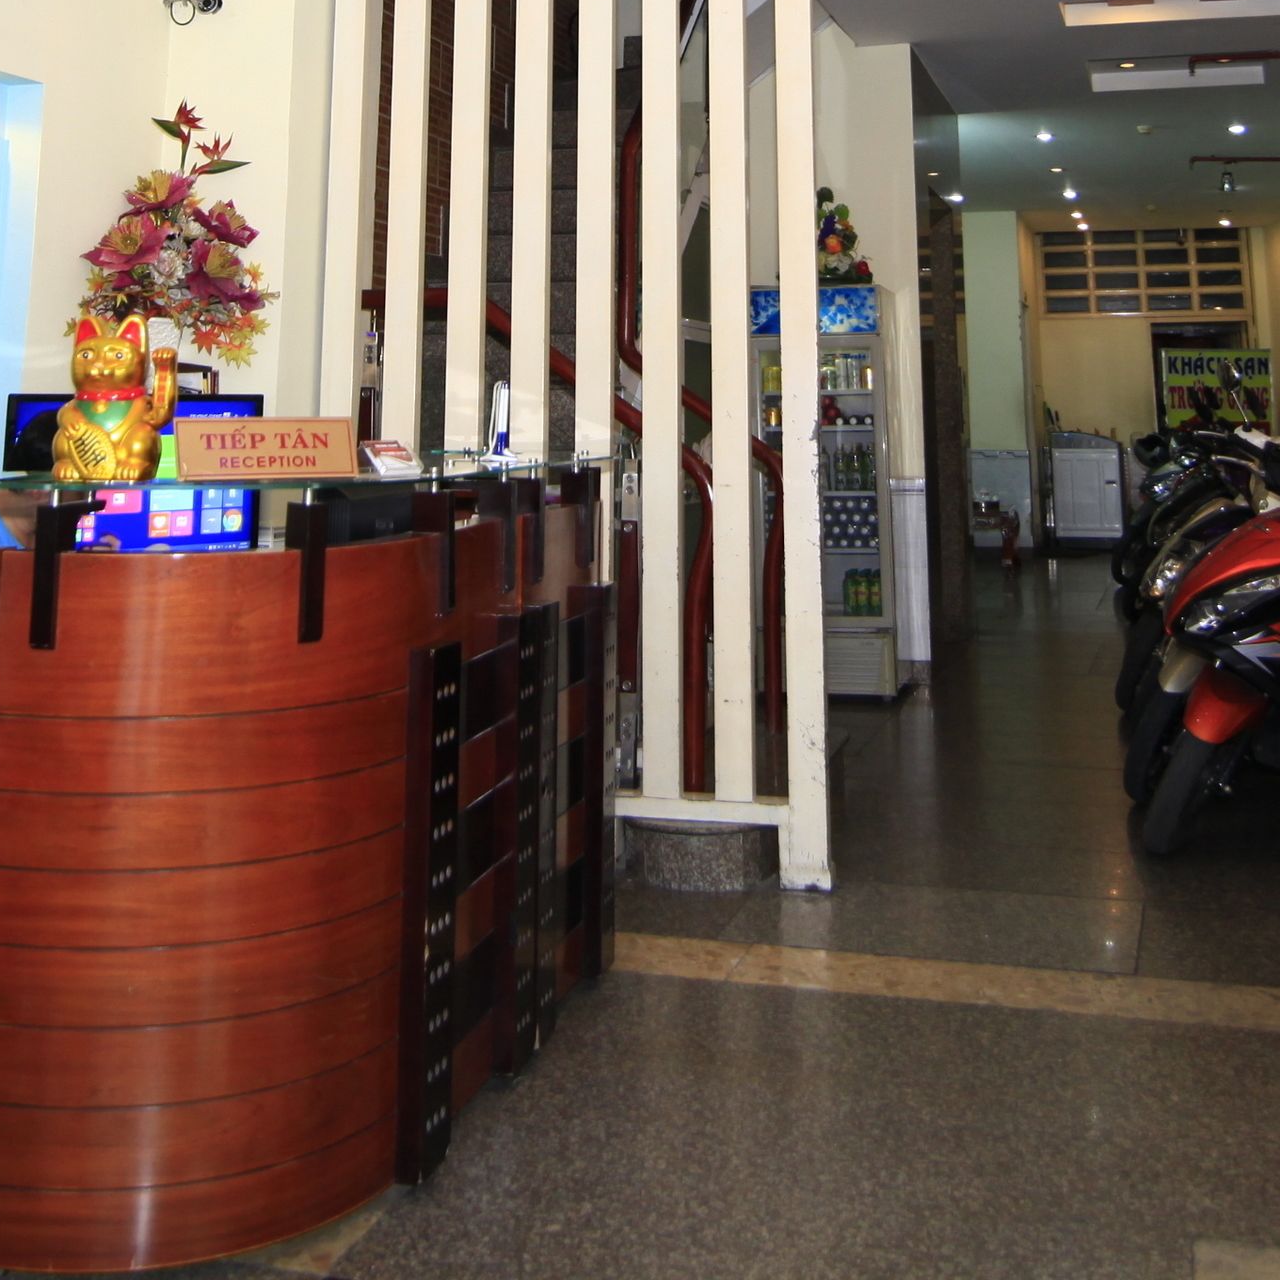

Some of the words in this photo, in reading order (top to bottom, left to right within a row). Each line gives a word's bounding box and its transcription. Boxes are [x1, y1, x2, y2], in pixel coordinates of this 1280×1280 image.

[200, 425, 266, 450] TIẾP
[274, 427, 329, 449] TÂN
[219, 455, 317, 469] RECEPTION
